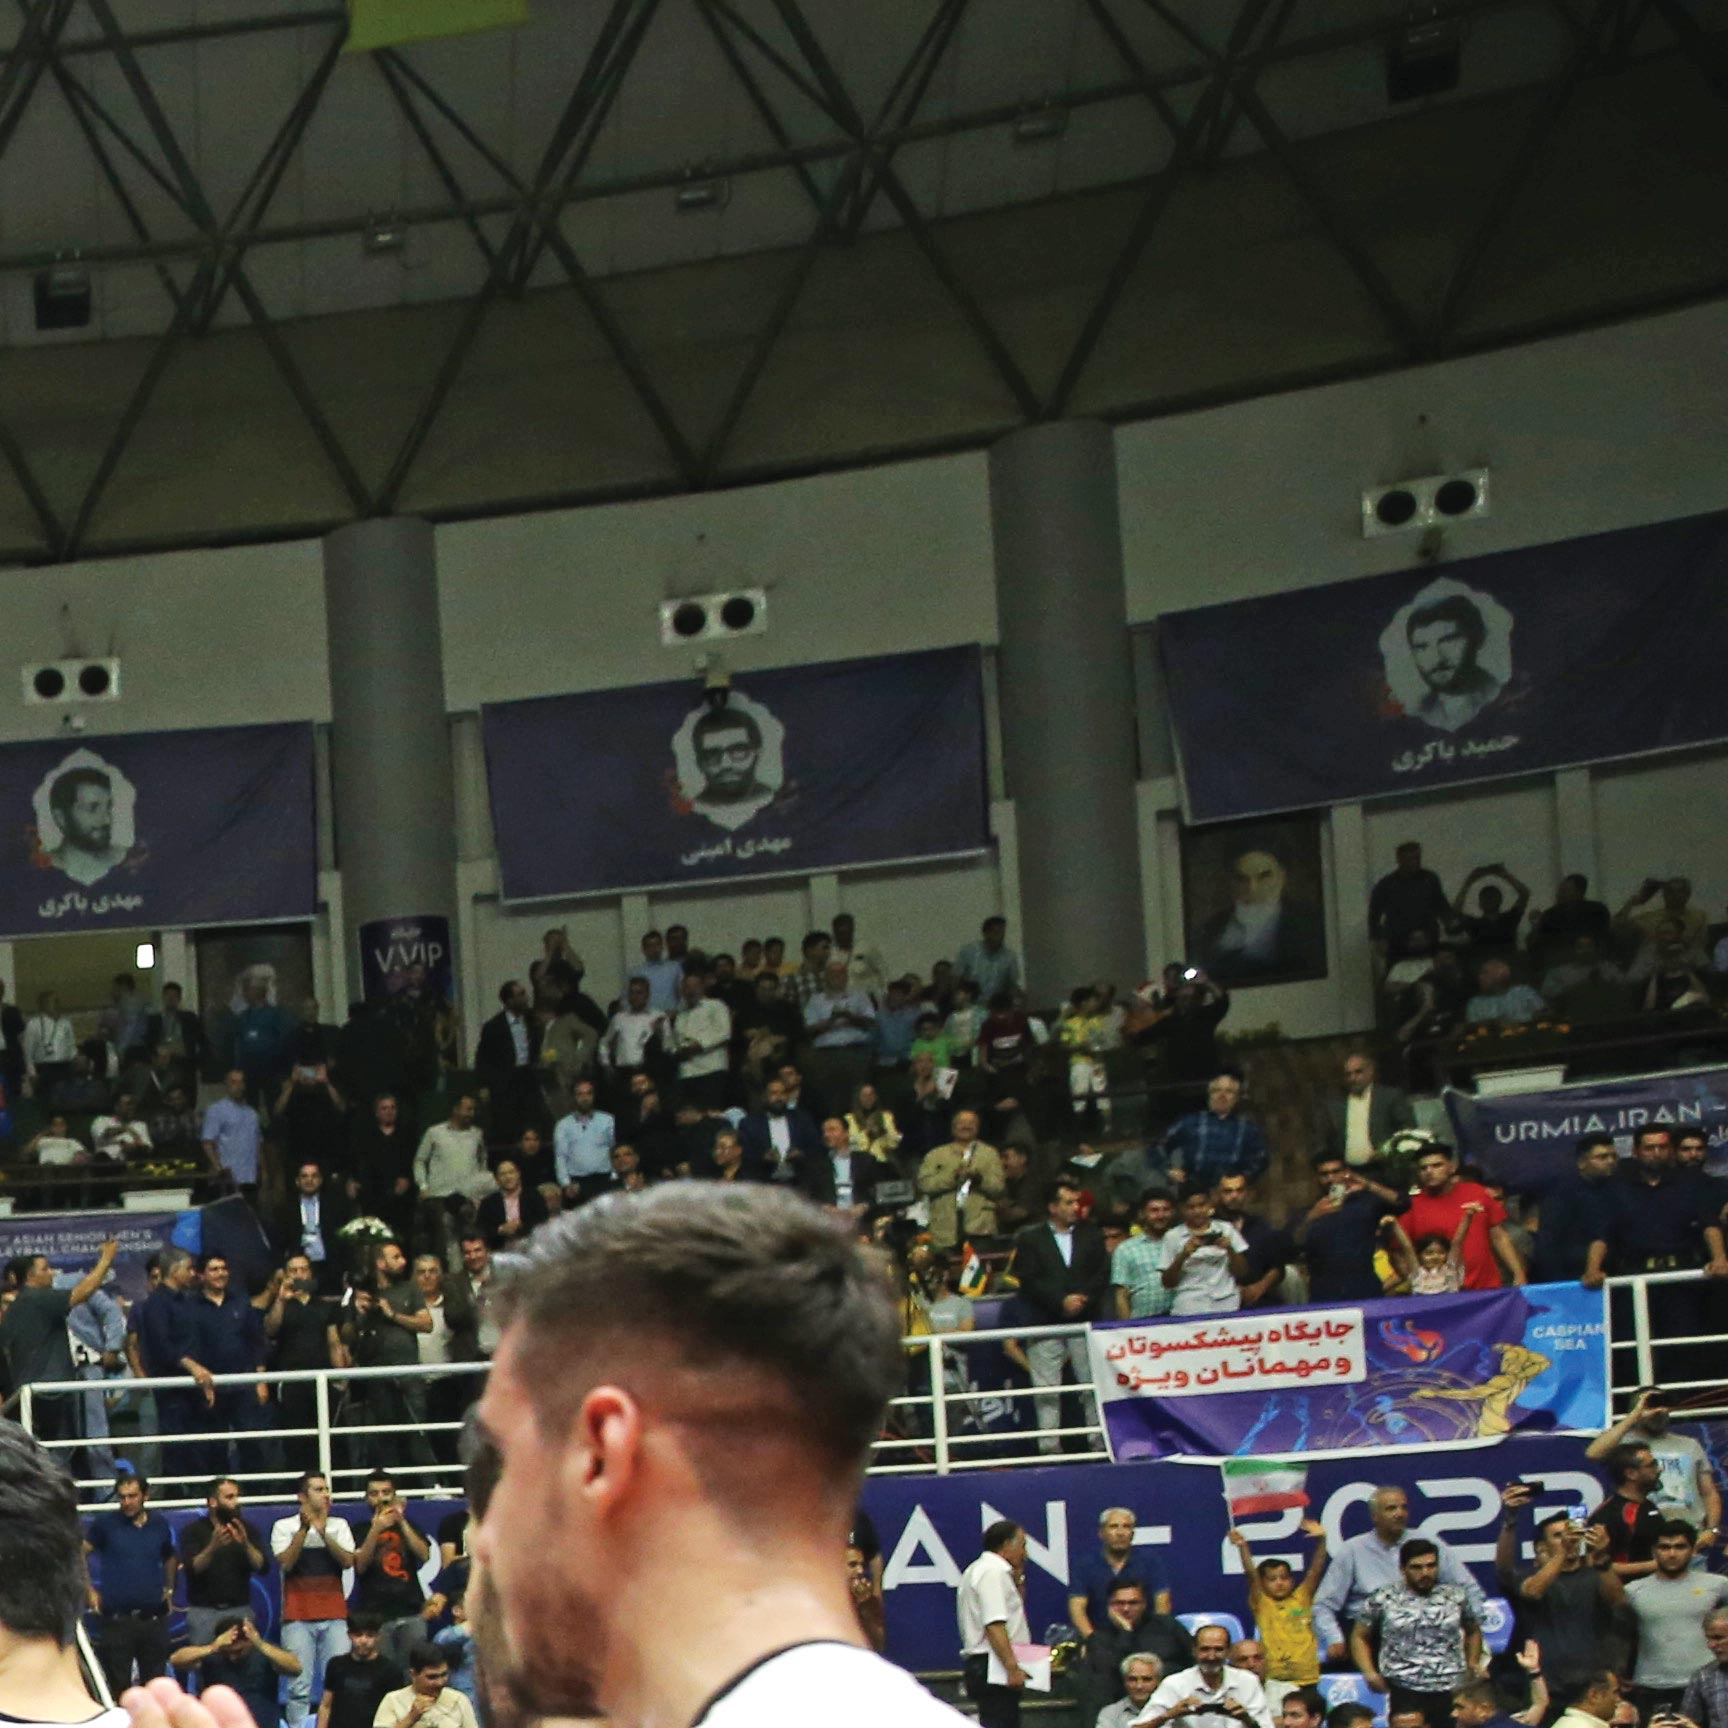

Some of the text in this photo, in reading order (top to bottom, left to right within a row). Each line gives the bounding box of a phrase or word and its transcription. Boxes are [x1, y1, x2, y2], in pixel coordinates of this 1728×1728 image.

[1392, 735, 1520, 772] حمید باکری
[736, 838, 792, 858] مهدی
[38, 892, 144, 918] مهدی باکری
[1105, 1316, 1355, 1361] جایگاه پیشکسوتان
[1532, 1323, 1605, 1340] CASPIAN
[1554, 1337, 1587, 1351] SEA
[1117, 1364, 1189, 1390] ویژه
[883, 1500, 1070, 1592] AN
